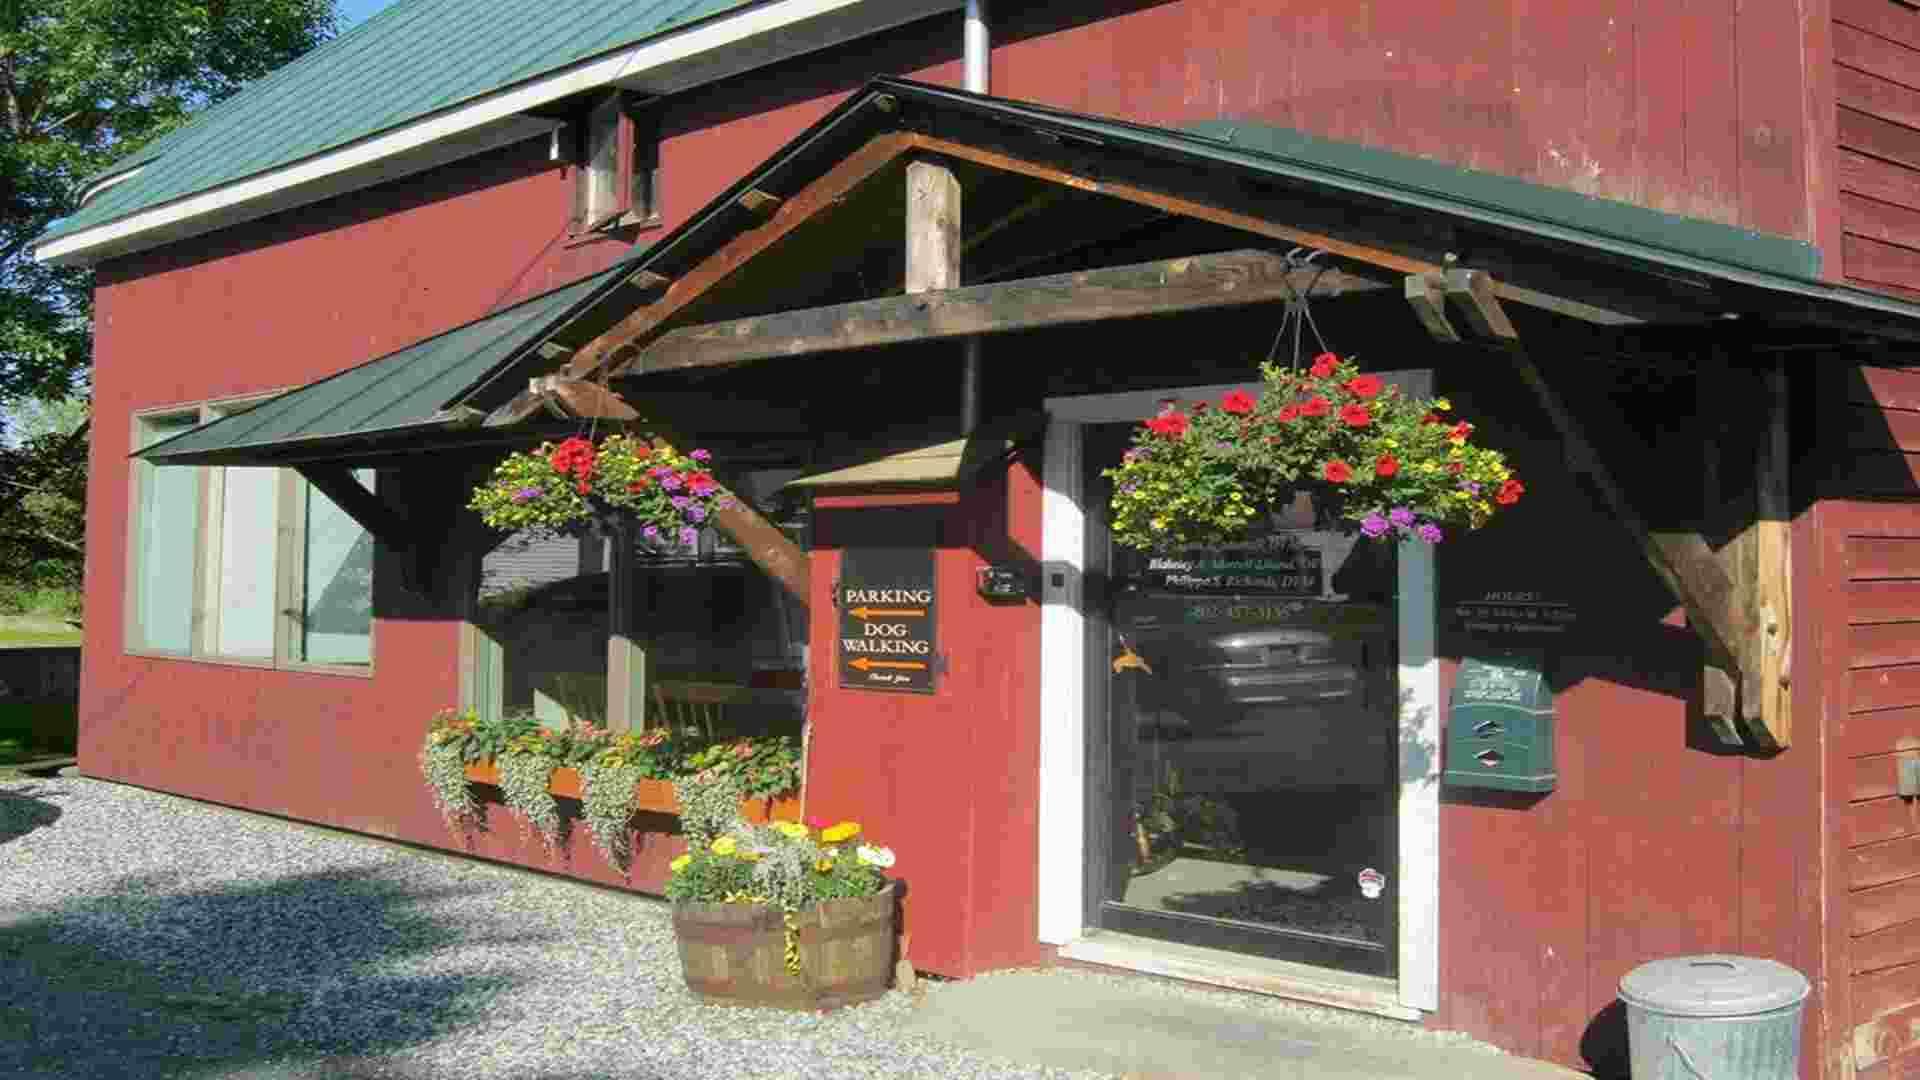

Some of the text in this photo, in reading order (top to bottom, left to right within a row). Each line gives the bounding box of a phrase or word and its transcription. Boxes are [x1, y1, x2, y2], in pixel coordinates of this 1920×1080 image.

[846, 589, 931, 603] PARKING
[864, 623, 908, 637] DOG
[842, 639, 929, 654] WALKING
